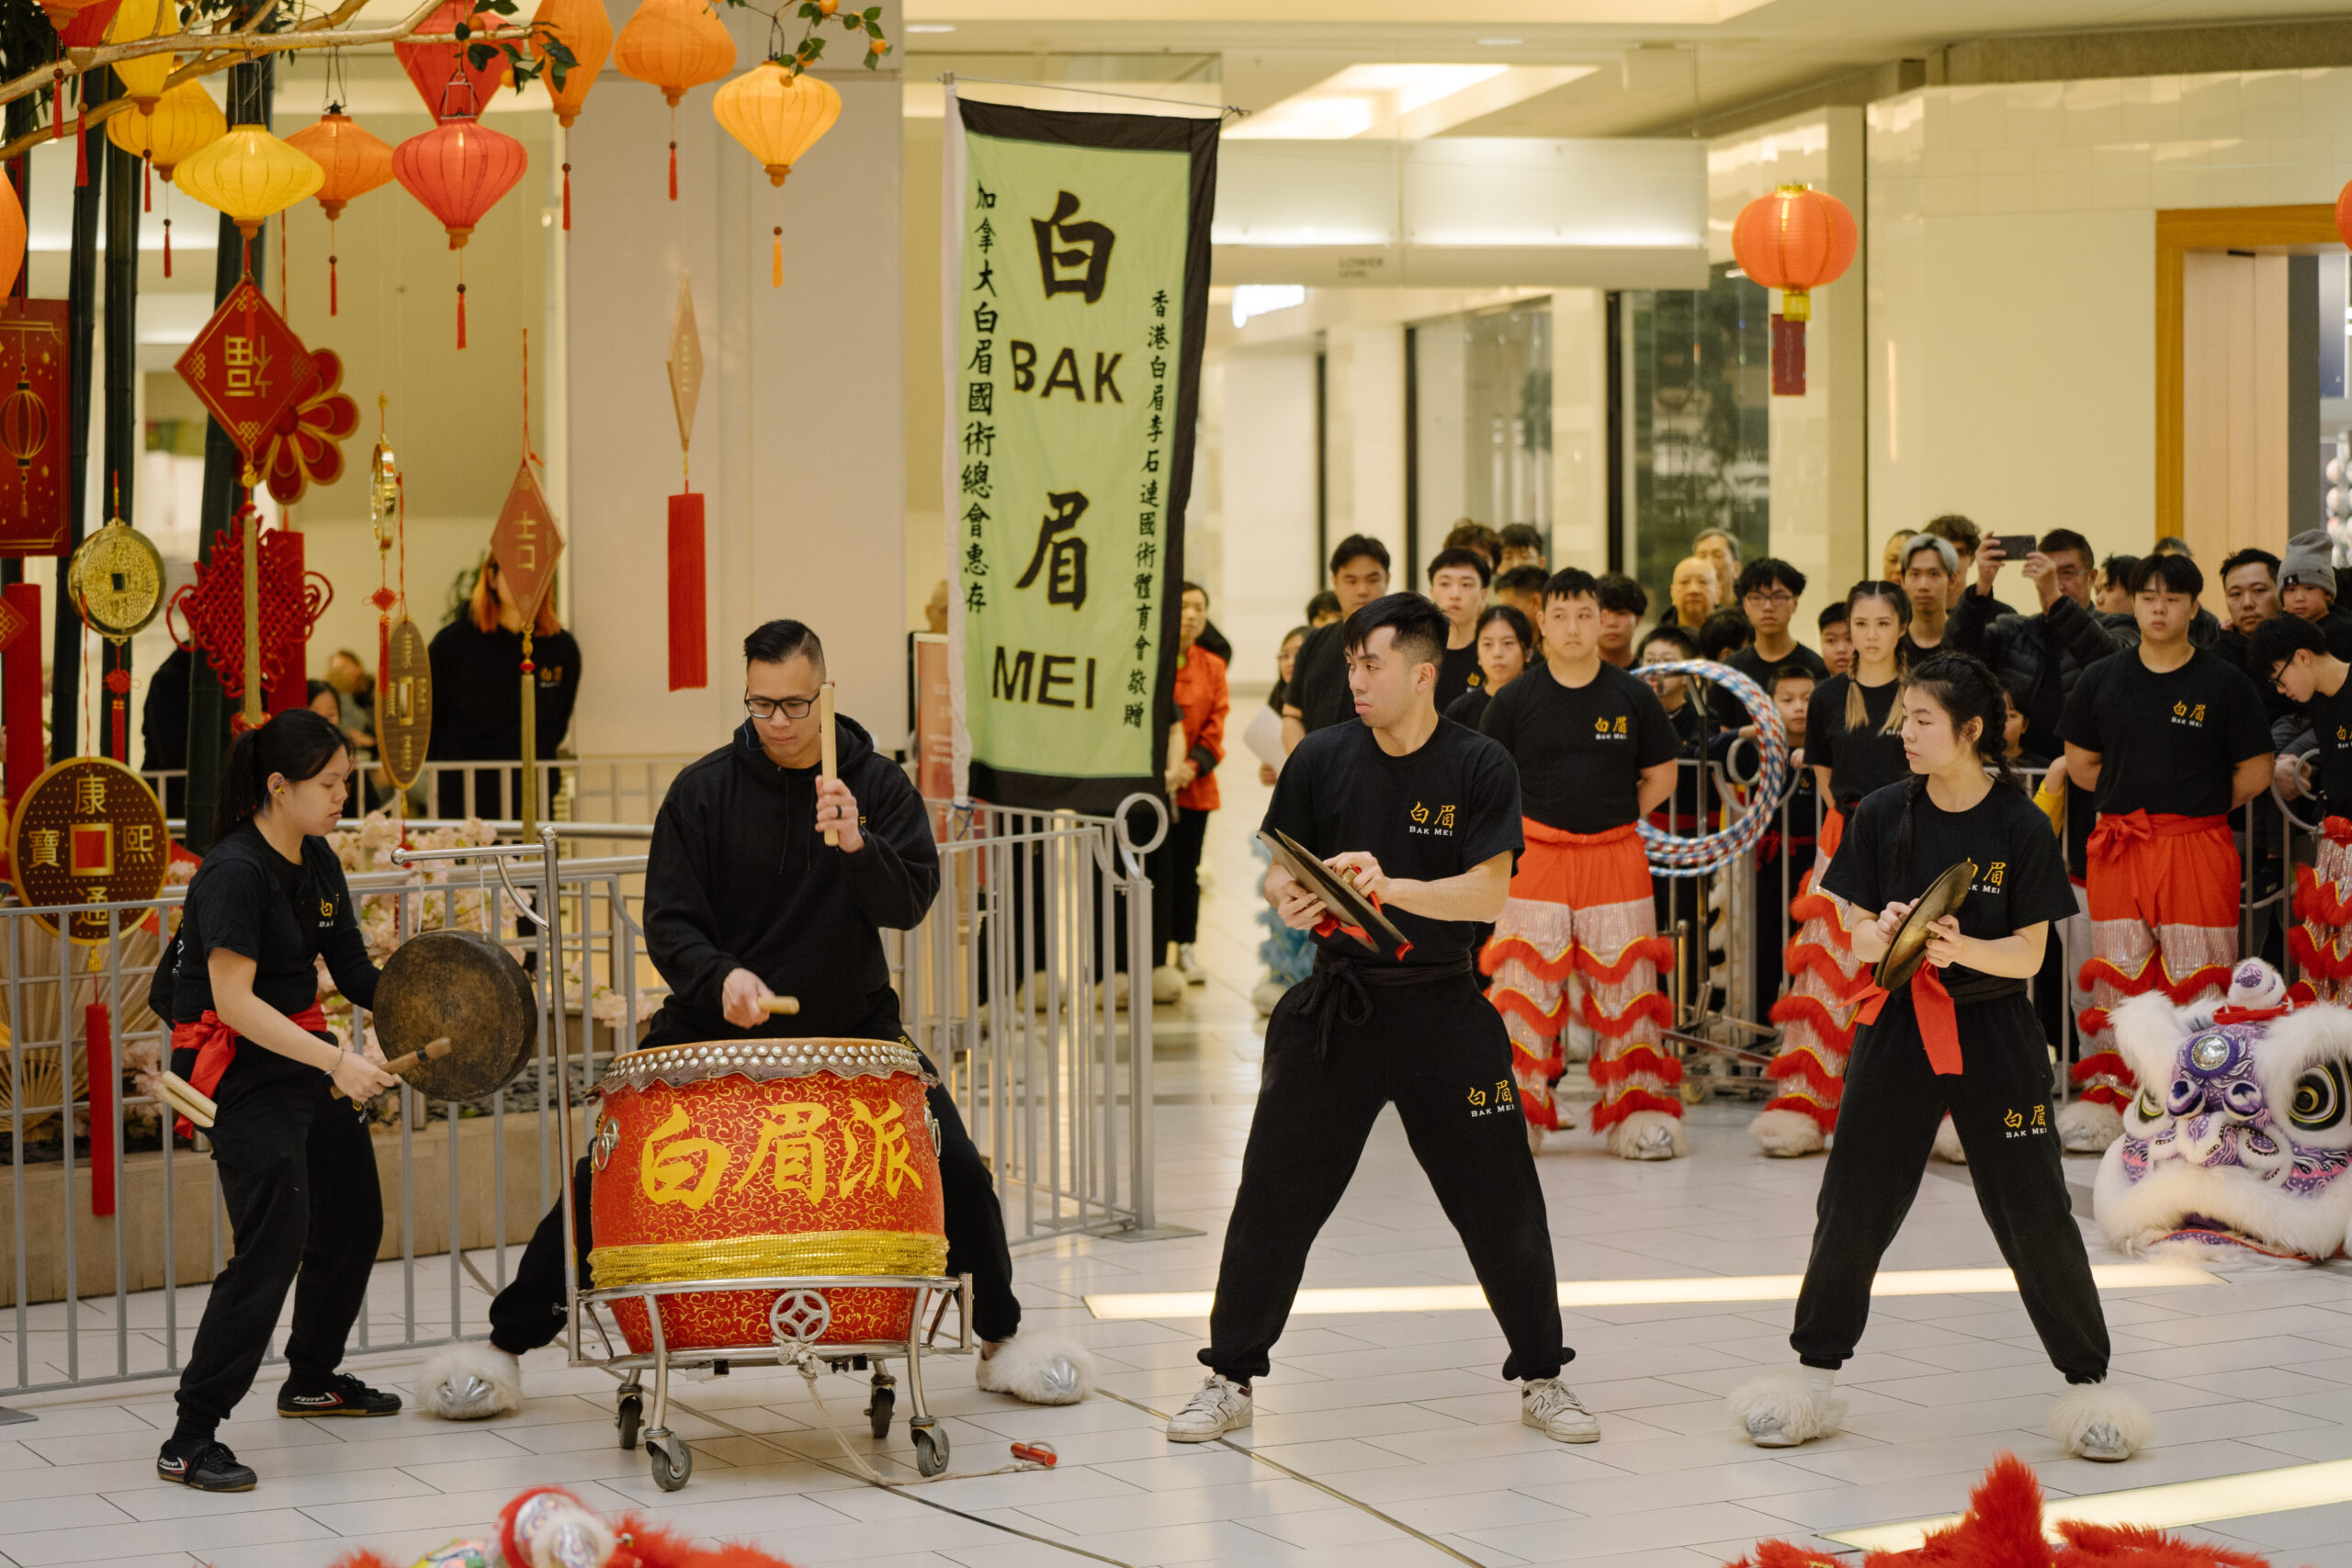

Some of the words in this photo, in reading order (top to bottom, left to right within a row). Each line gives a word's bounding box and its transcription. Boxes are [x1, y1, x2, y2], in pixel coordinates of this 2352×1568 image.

[1030, 189, 1116, 306] 白
[1011, 339, 1125, 404] BAK
[962, 180, 1000, 615] 加拿大白眉國術總會惠存
[1014, 491, 1089, 612] 眉
[992, 646, 1097, 710] MEI
[74, 773, 107, 815] 康
[1409, 826, 1430, 835] BAK
[1434, 829, 1453, 837] MEI
[1410, 801, 1456, 829] 白眉
[28, 828, 61, 868] 寶
[123, 825, 154, 863] 熙
[1983, 885, 2000, 894] MEI
[1466, 1079, 1512, 1106] 白眉
[1471, 1108, 1492, 1117] BAK
[1497, 1104, 1515, 1112] MEI
[2004, 1104, 2046, 1128] 白眉
[2006, 1130, 2027, 1138] BAK
[642, 1099, 922, 1210] 白眉派
